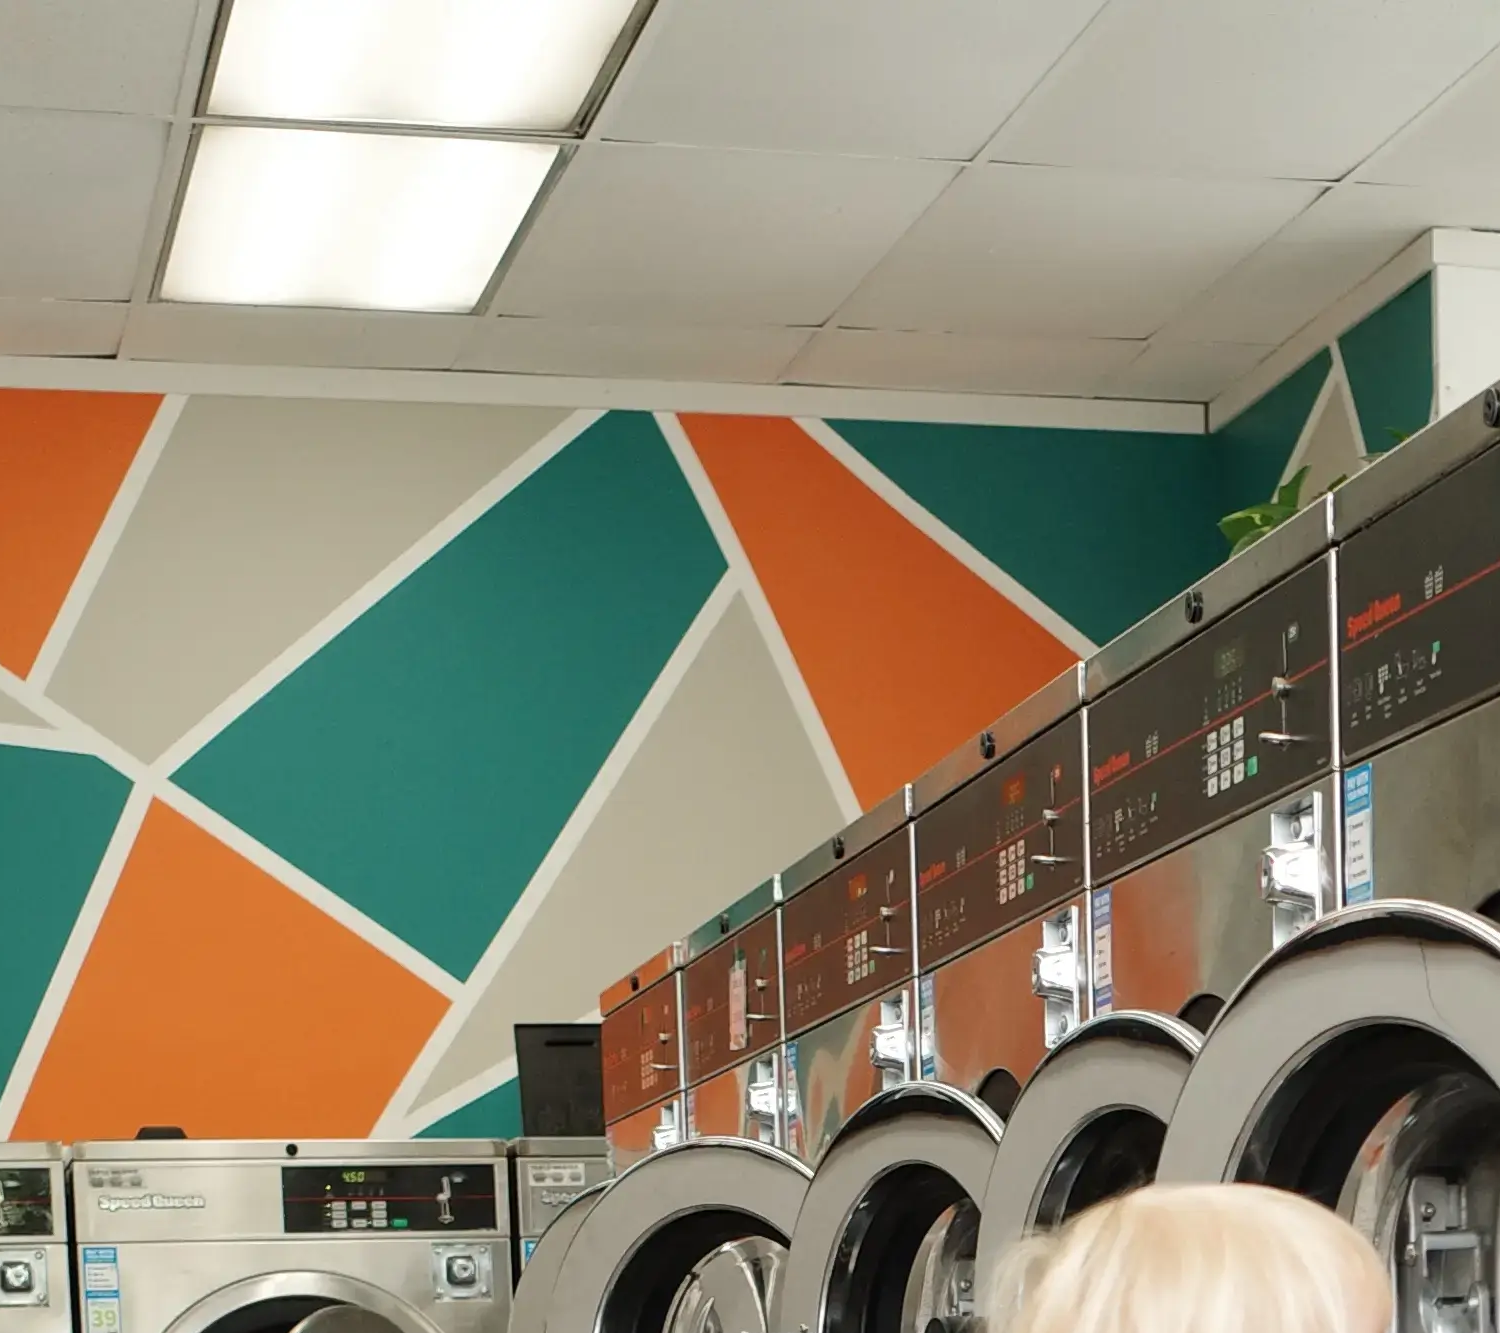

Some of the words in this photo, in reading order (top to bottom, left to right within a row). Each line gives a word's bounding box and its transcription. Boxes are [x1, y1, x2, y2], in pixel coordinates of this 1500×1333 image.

[98, 1193, 152, 1213] Speed
[152, 1193, 206, 1210] Queen
[92, 1308, 117, 1328] 39
